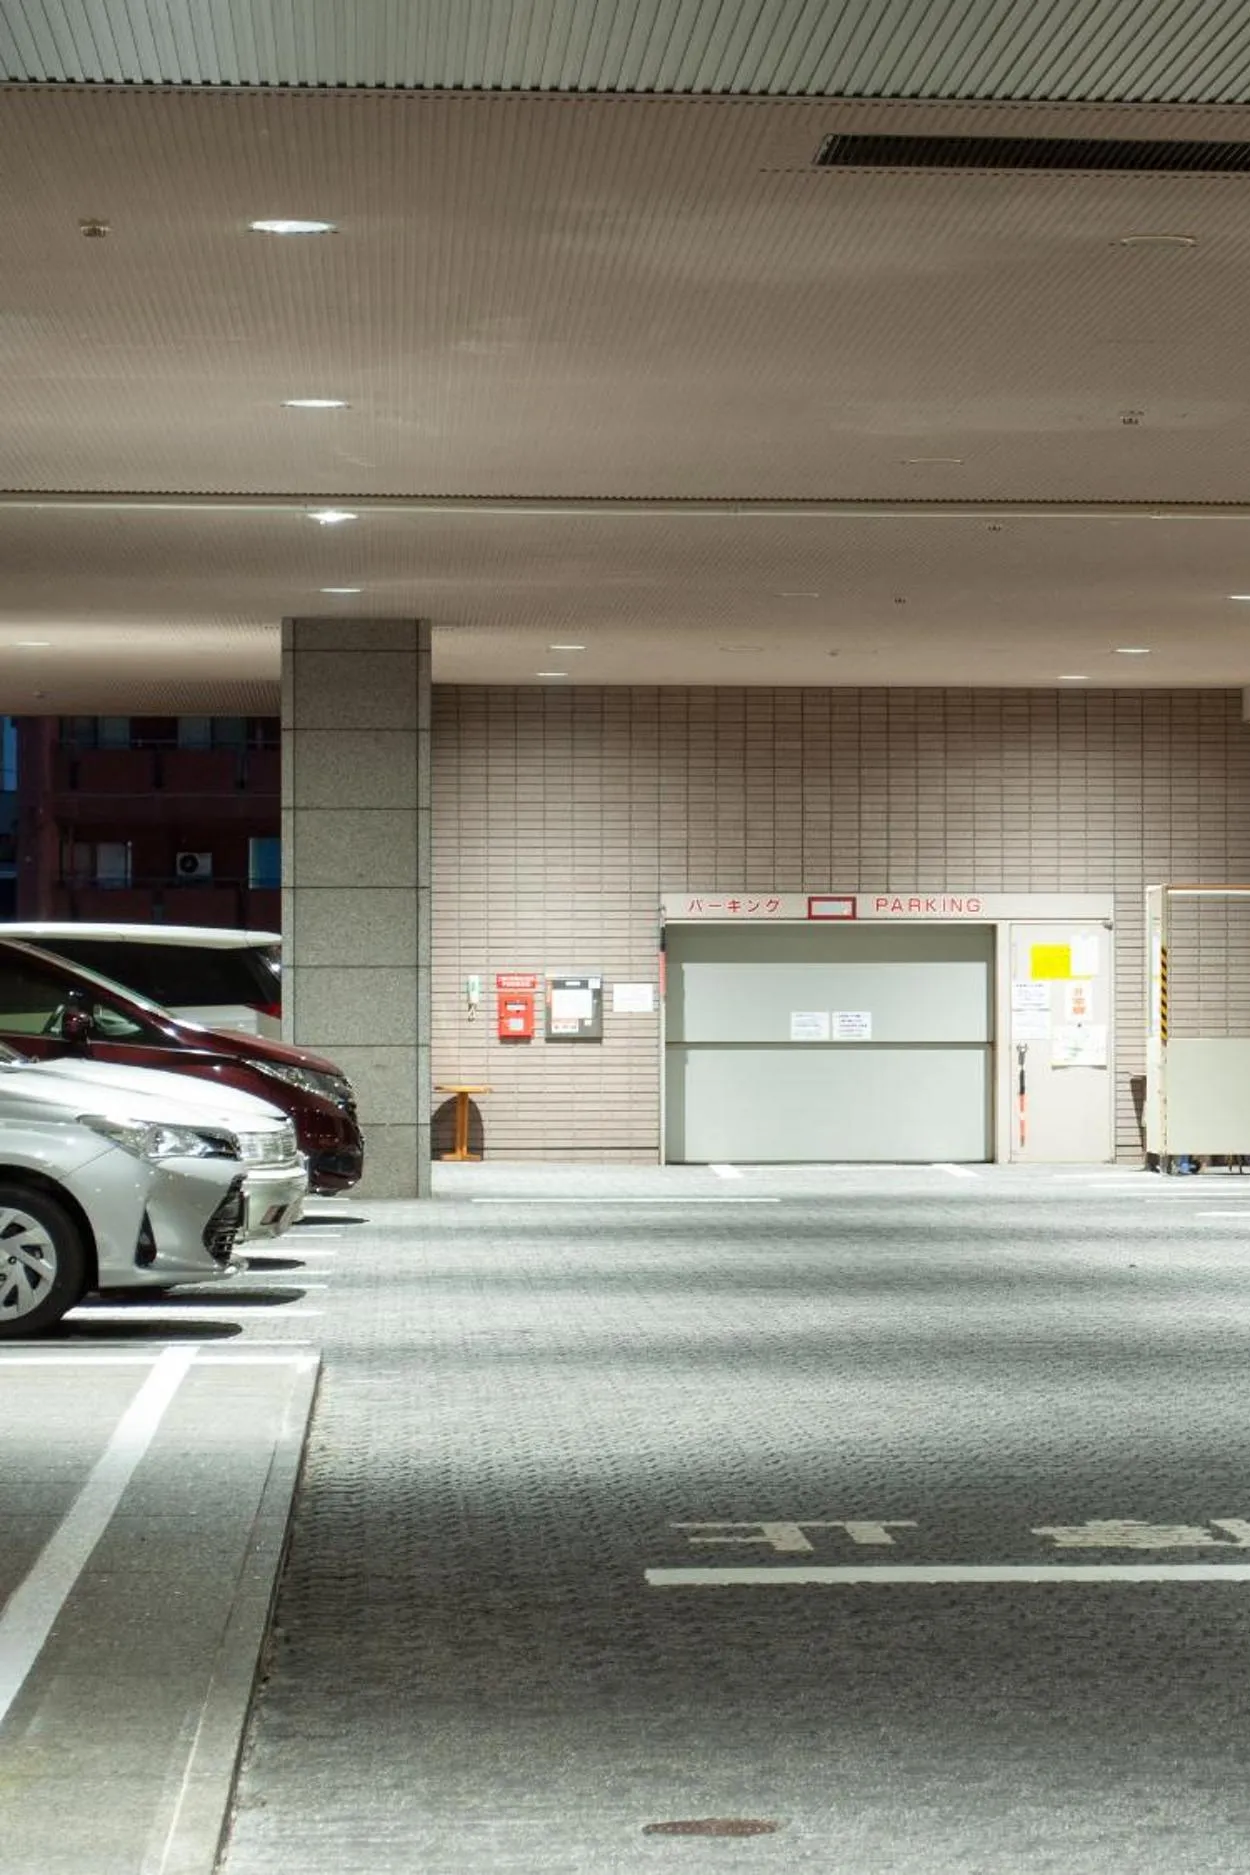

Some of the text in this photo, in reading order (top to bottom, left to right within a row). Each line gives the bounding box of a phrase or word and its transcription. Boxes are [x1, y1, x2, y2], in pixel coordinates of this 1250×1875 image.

[688, 898, 781, 913] パーキング
[875, 897, 983, 913] PARKING
